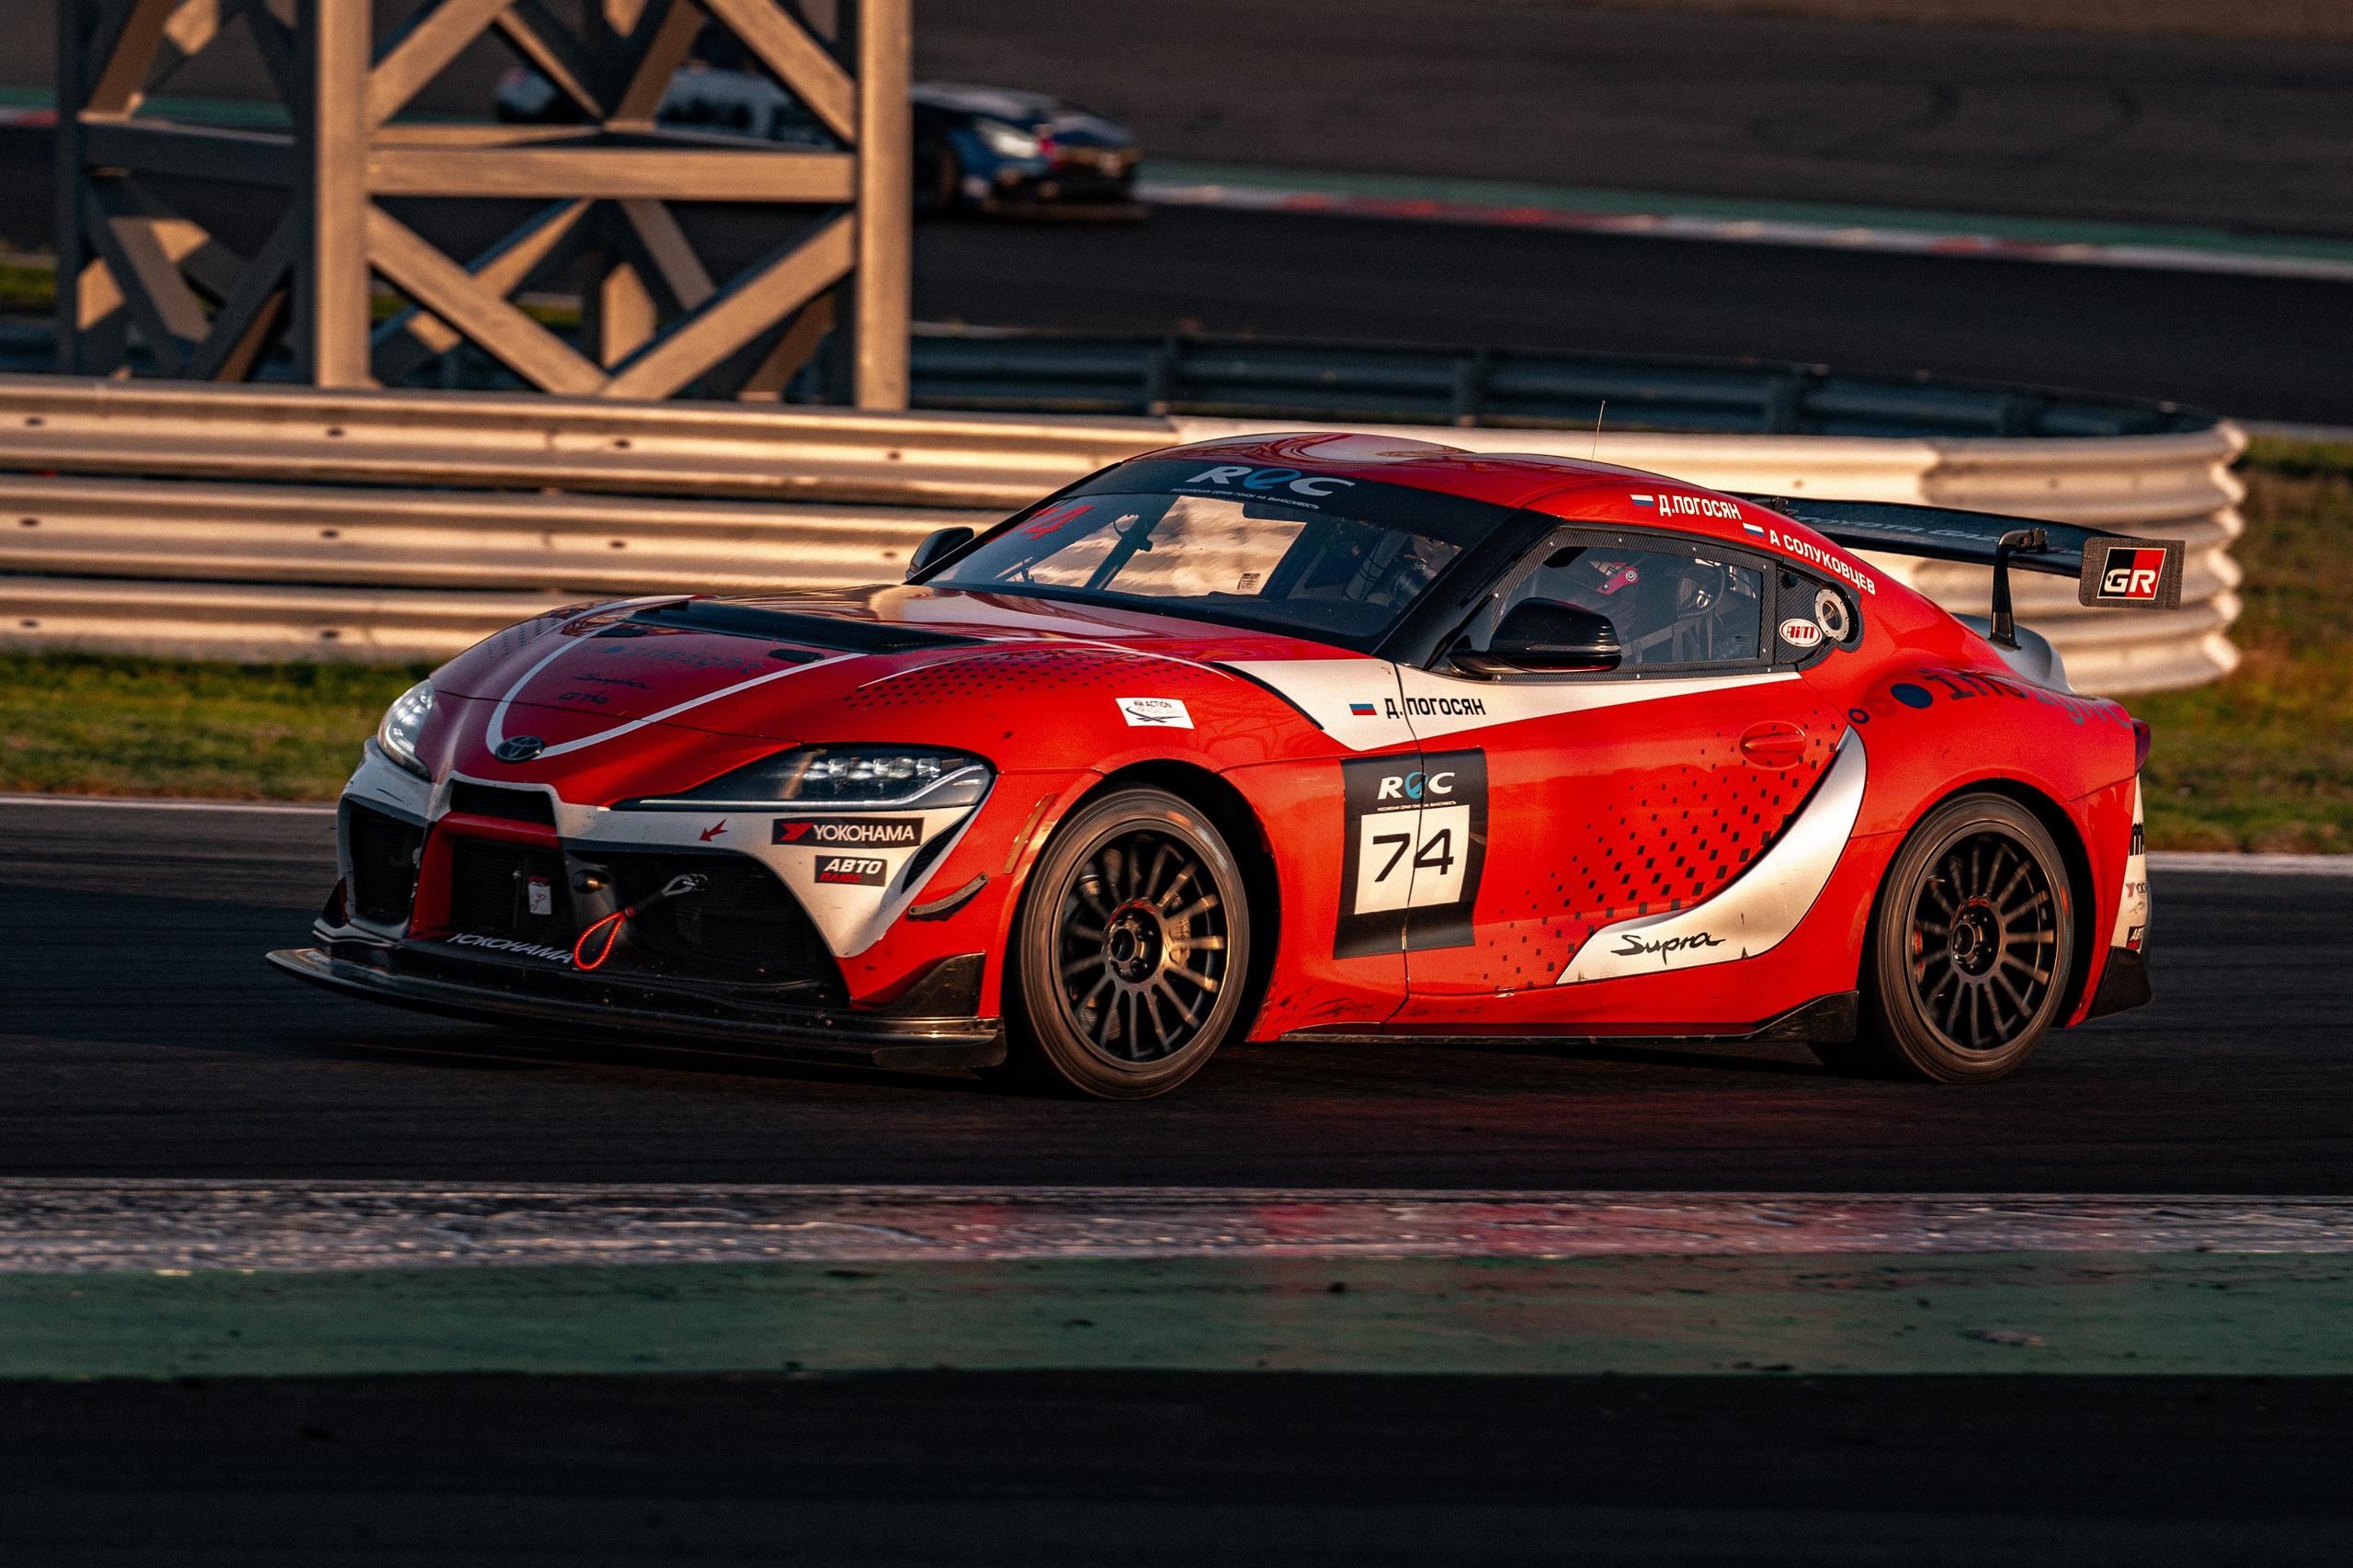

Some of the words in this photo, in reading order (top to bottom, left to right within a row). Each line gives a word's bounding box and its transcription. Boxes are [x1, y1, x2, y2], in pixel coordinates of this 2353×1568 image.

[1658, 494, 1743, 520] Д.ПОГОСЯН
[1786, 535, 1876, 596] СОЛУКОВЦЕВ
[2104, 569, 2156, 594] GR
[1405, 698, 1486, 715] ПОГОСЯН
[813, 824, 915, 841] YOKOHAMA
[824, 858, 883, 874] АВТО
[1372, 828, 1454, 882] 74
[446, 933, 575, 963] YOKOHAMA
[1610, 932, 1726, 965] Supra
